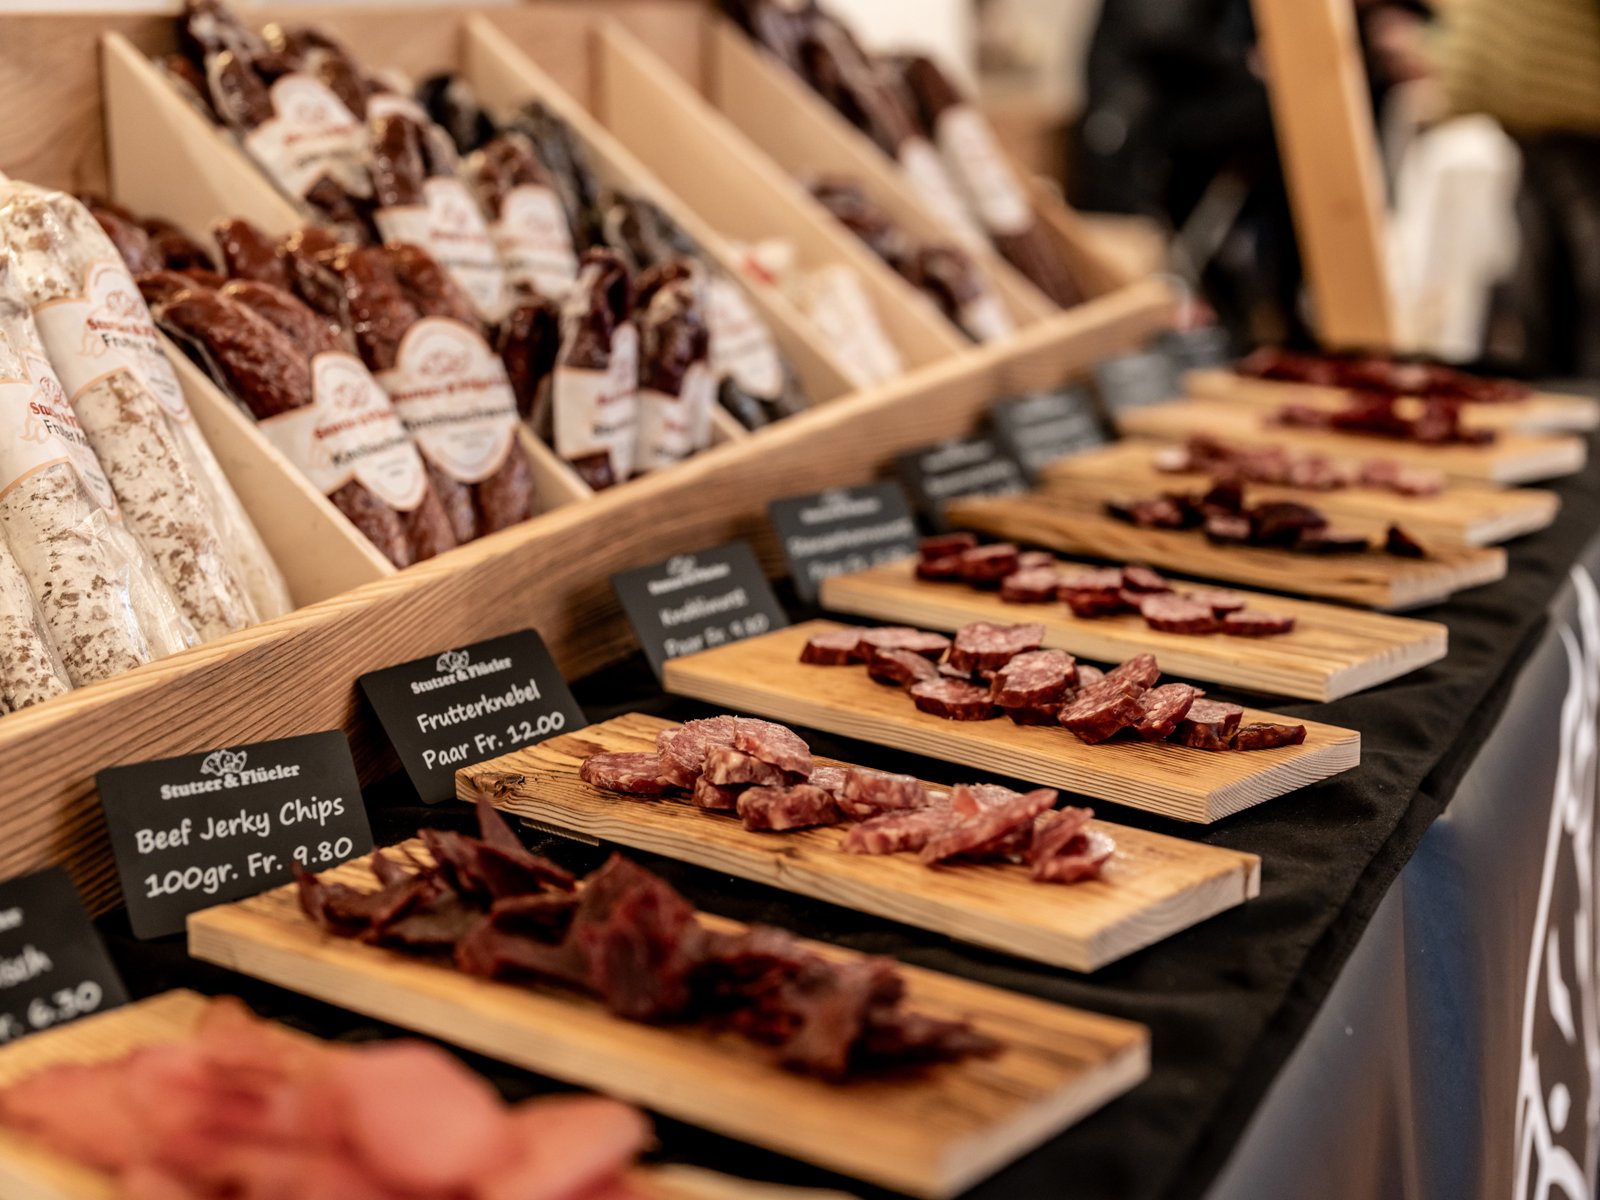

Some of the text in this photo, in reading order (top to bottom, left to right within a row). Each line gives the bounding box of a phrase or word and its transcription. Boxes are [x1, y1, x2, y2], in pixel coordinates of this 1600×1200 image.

[416, 678, 541, 734] Frutterknebel
[422, 711, 566, 770] Paar Fr. 12.00
[160, 776, 223, 801] Stutzer
[223, 772, 240, 789] &
[135, 795, 345, 854] Beef Jerky Chips
[144, 836, 353, 899] 100gr. Fr. 9.80
